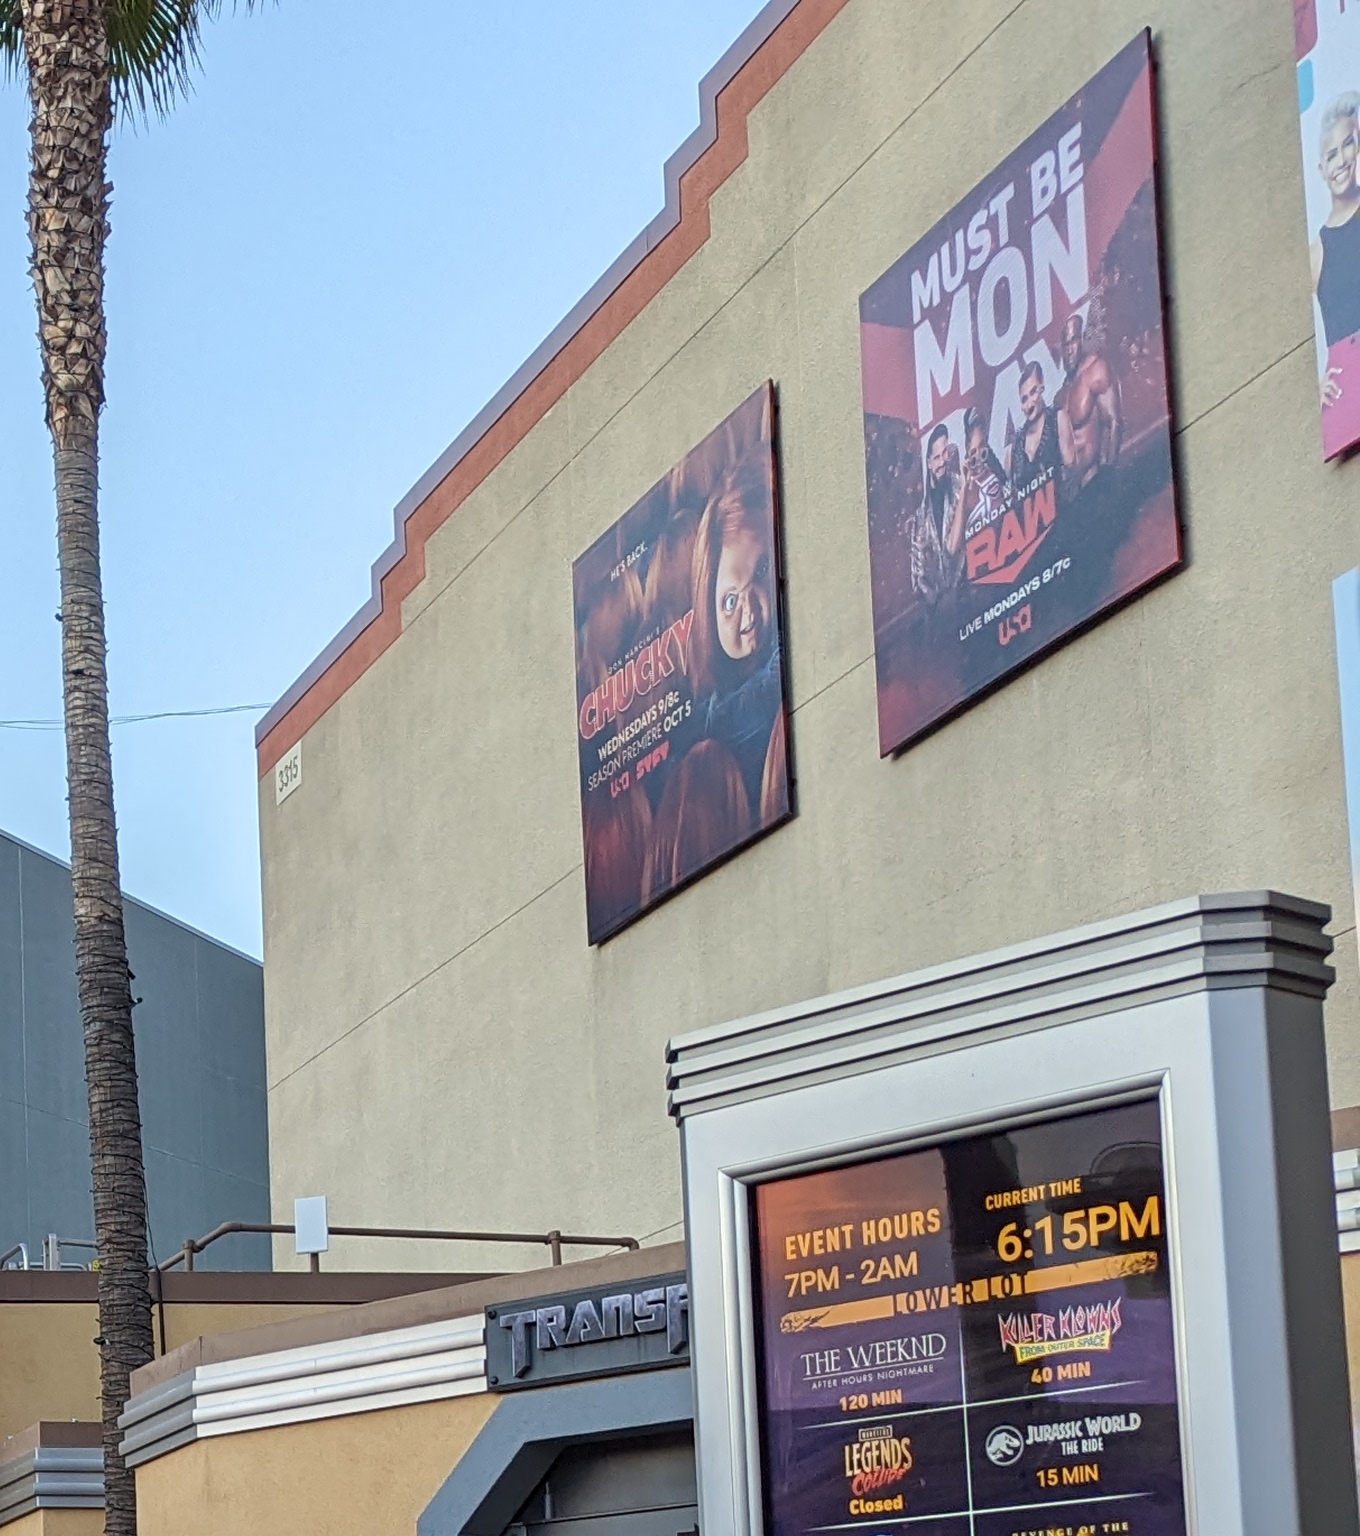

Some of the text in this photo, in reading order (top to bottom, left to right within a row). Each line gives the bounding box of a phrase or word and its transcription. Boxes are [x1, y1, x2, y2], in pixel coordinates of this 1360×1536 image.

[910, 122, 1084, 325] MUST BE
[913, 183, 1090, 431] MON
[965, 466, 1055, 540] MONDAY NIGHT
[966, 480, 1057, 581] RAW
[959, 617, 983, 642] LIVE
[984, 576, 1040, 625] MONDAYS
[579, 608, 695, 740] CHUCKY
[587, 699, 693, 792] SEASON PREMIERE OCT 5
[597, 705, 658, 762] WEDNESDAYS
[985, 1177, 1082, 1211] CURRENT TIME
[785, 1208, 942, 1261] EVENT HOURS
[997, 1195, 1161, 1262] 6:15PM
[784, 1266, 840, 1298] 7PM
[860, 1251, 918, 1284] 2AM
[893, 1281, 974, 1315] LOWER
[998, 1296, 1122, 1353] KILLER KLOWNS
[1019, 1344, 1046, 1360] FROM
[1076, 1332, 1107, 1348] SPACE
[801, 1333, 947, 1376] THE WEEKND
[1031, 1361, 1092, 1384] 40 MIN
[811, 1364, 934, 1391] AFTER HOURS NIGHTMARE
[839, 1388, 903, 1411] 120 MIN
[1025, 1412, 1142, 1445] JURASSIC WORLD
[1061, 1437, 1104, 1456] THE RIDE
[844, 1437, 913, 1477] LEGENDS
[1036, 1463, 1099, 1488] 15 MIN
[849, 1494, 904, 1515] Closed
[1079, 1524, 1096, 1534] OF
[1102, 1521, 1129, 1532] THE
